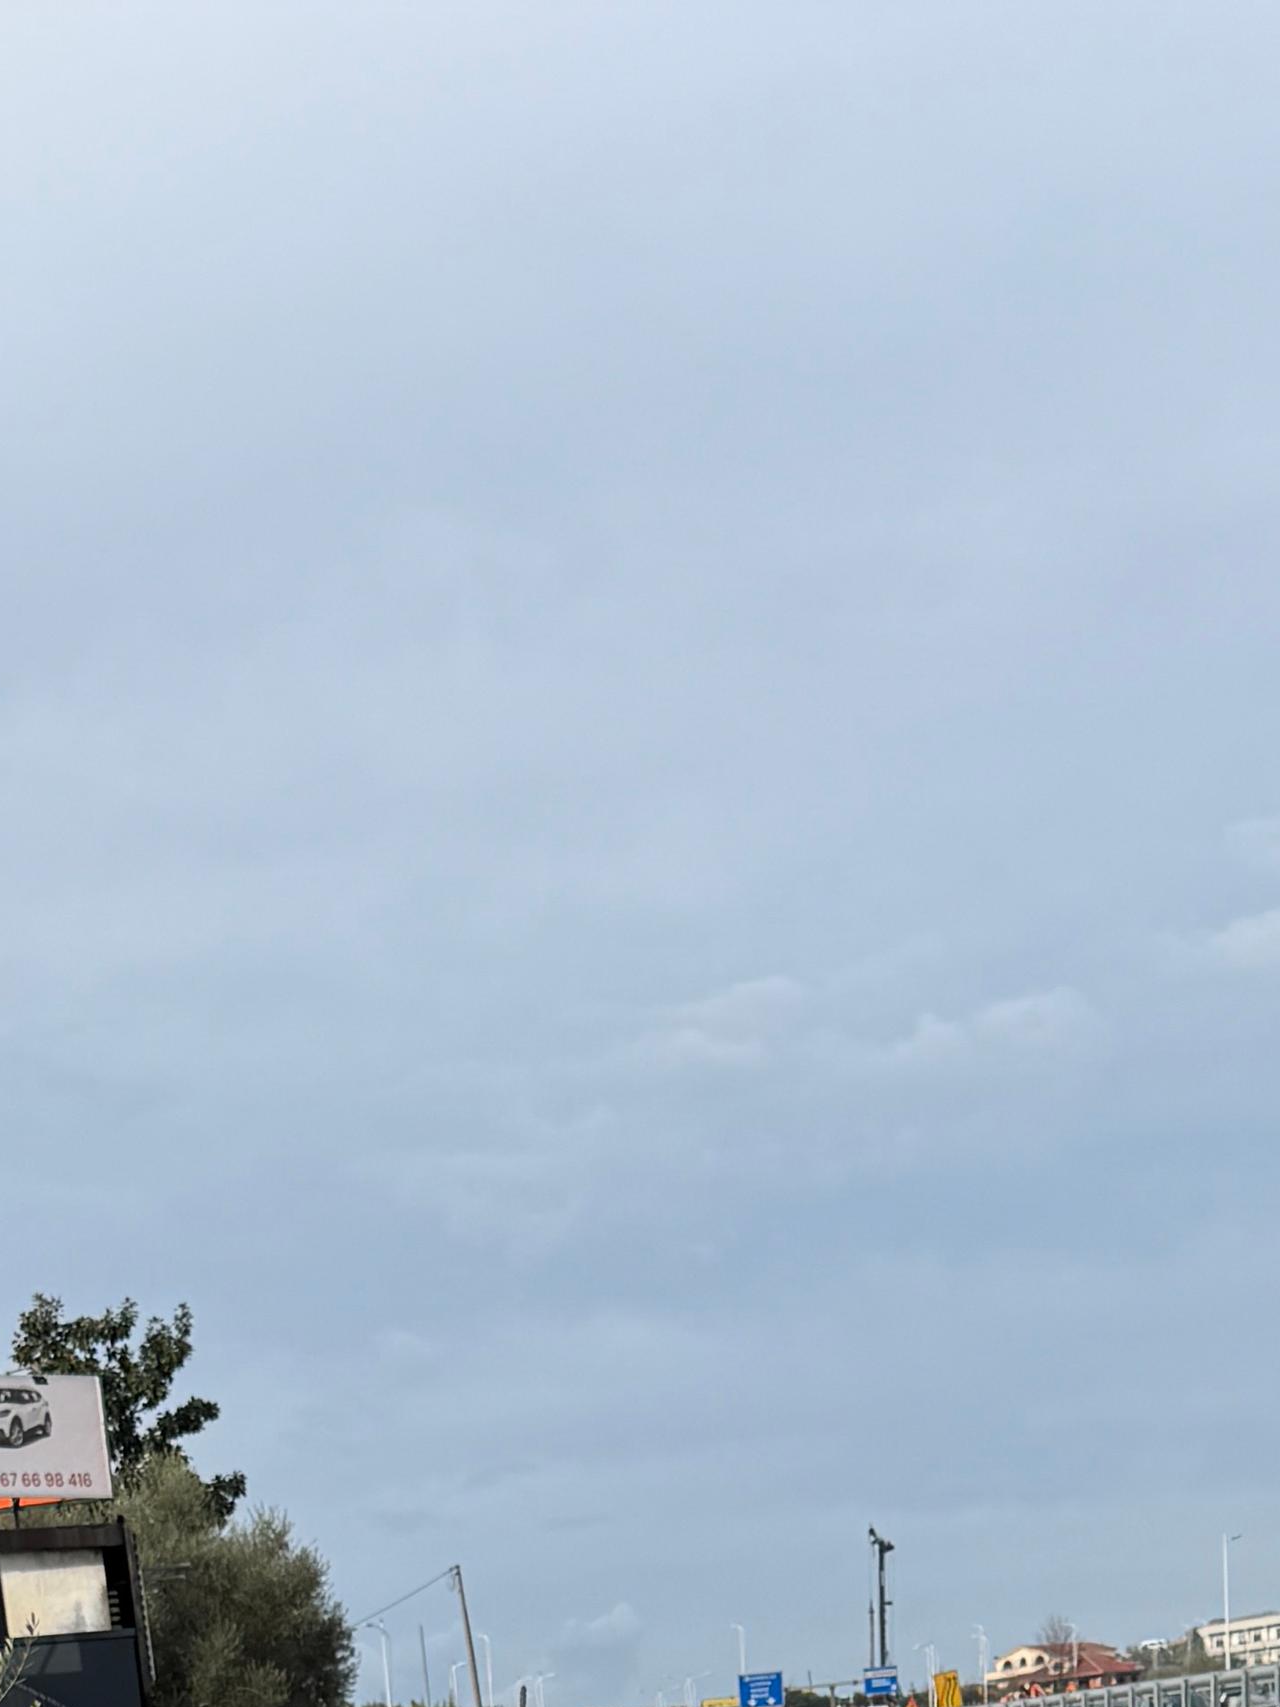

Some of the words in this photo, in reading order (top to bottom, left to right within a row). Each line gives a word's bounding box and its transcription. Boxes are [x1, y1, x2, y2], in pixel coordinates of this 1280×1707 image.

[0, 1472, 17, 1487] 67
[21, 1472, 41, 1487] 66
[44, 1472, 64, 1487] 98
[68, 1472, 92, 1487] 416
